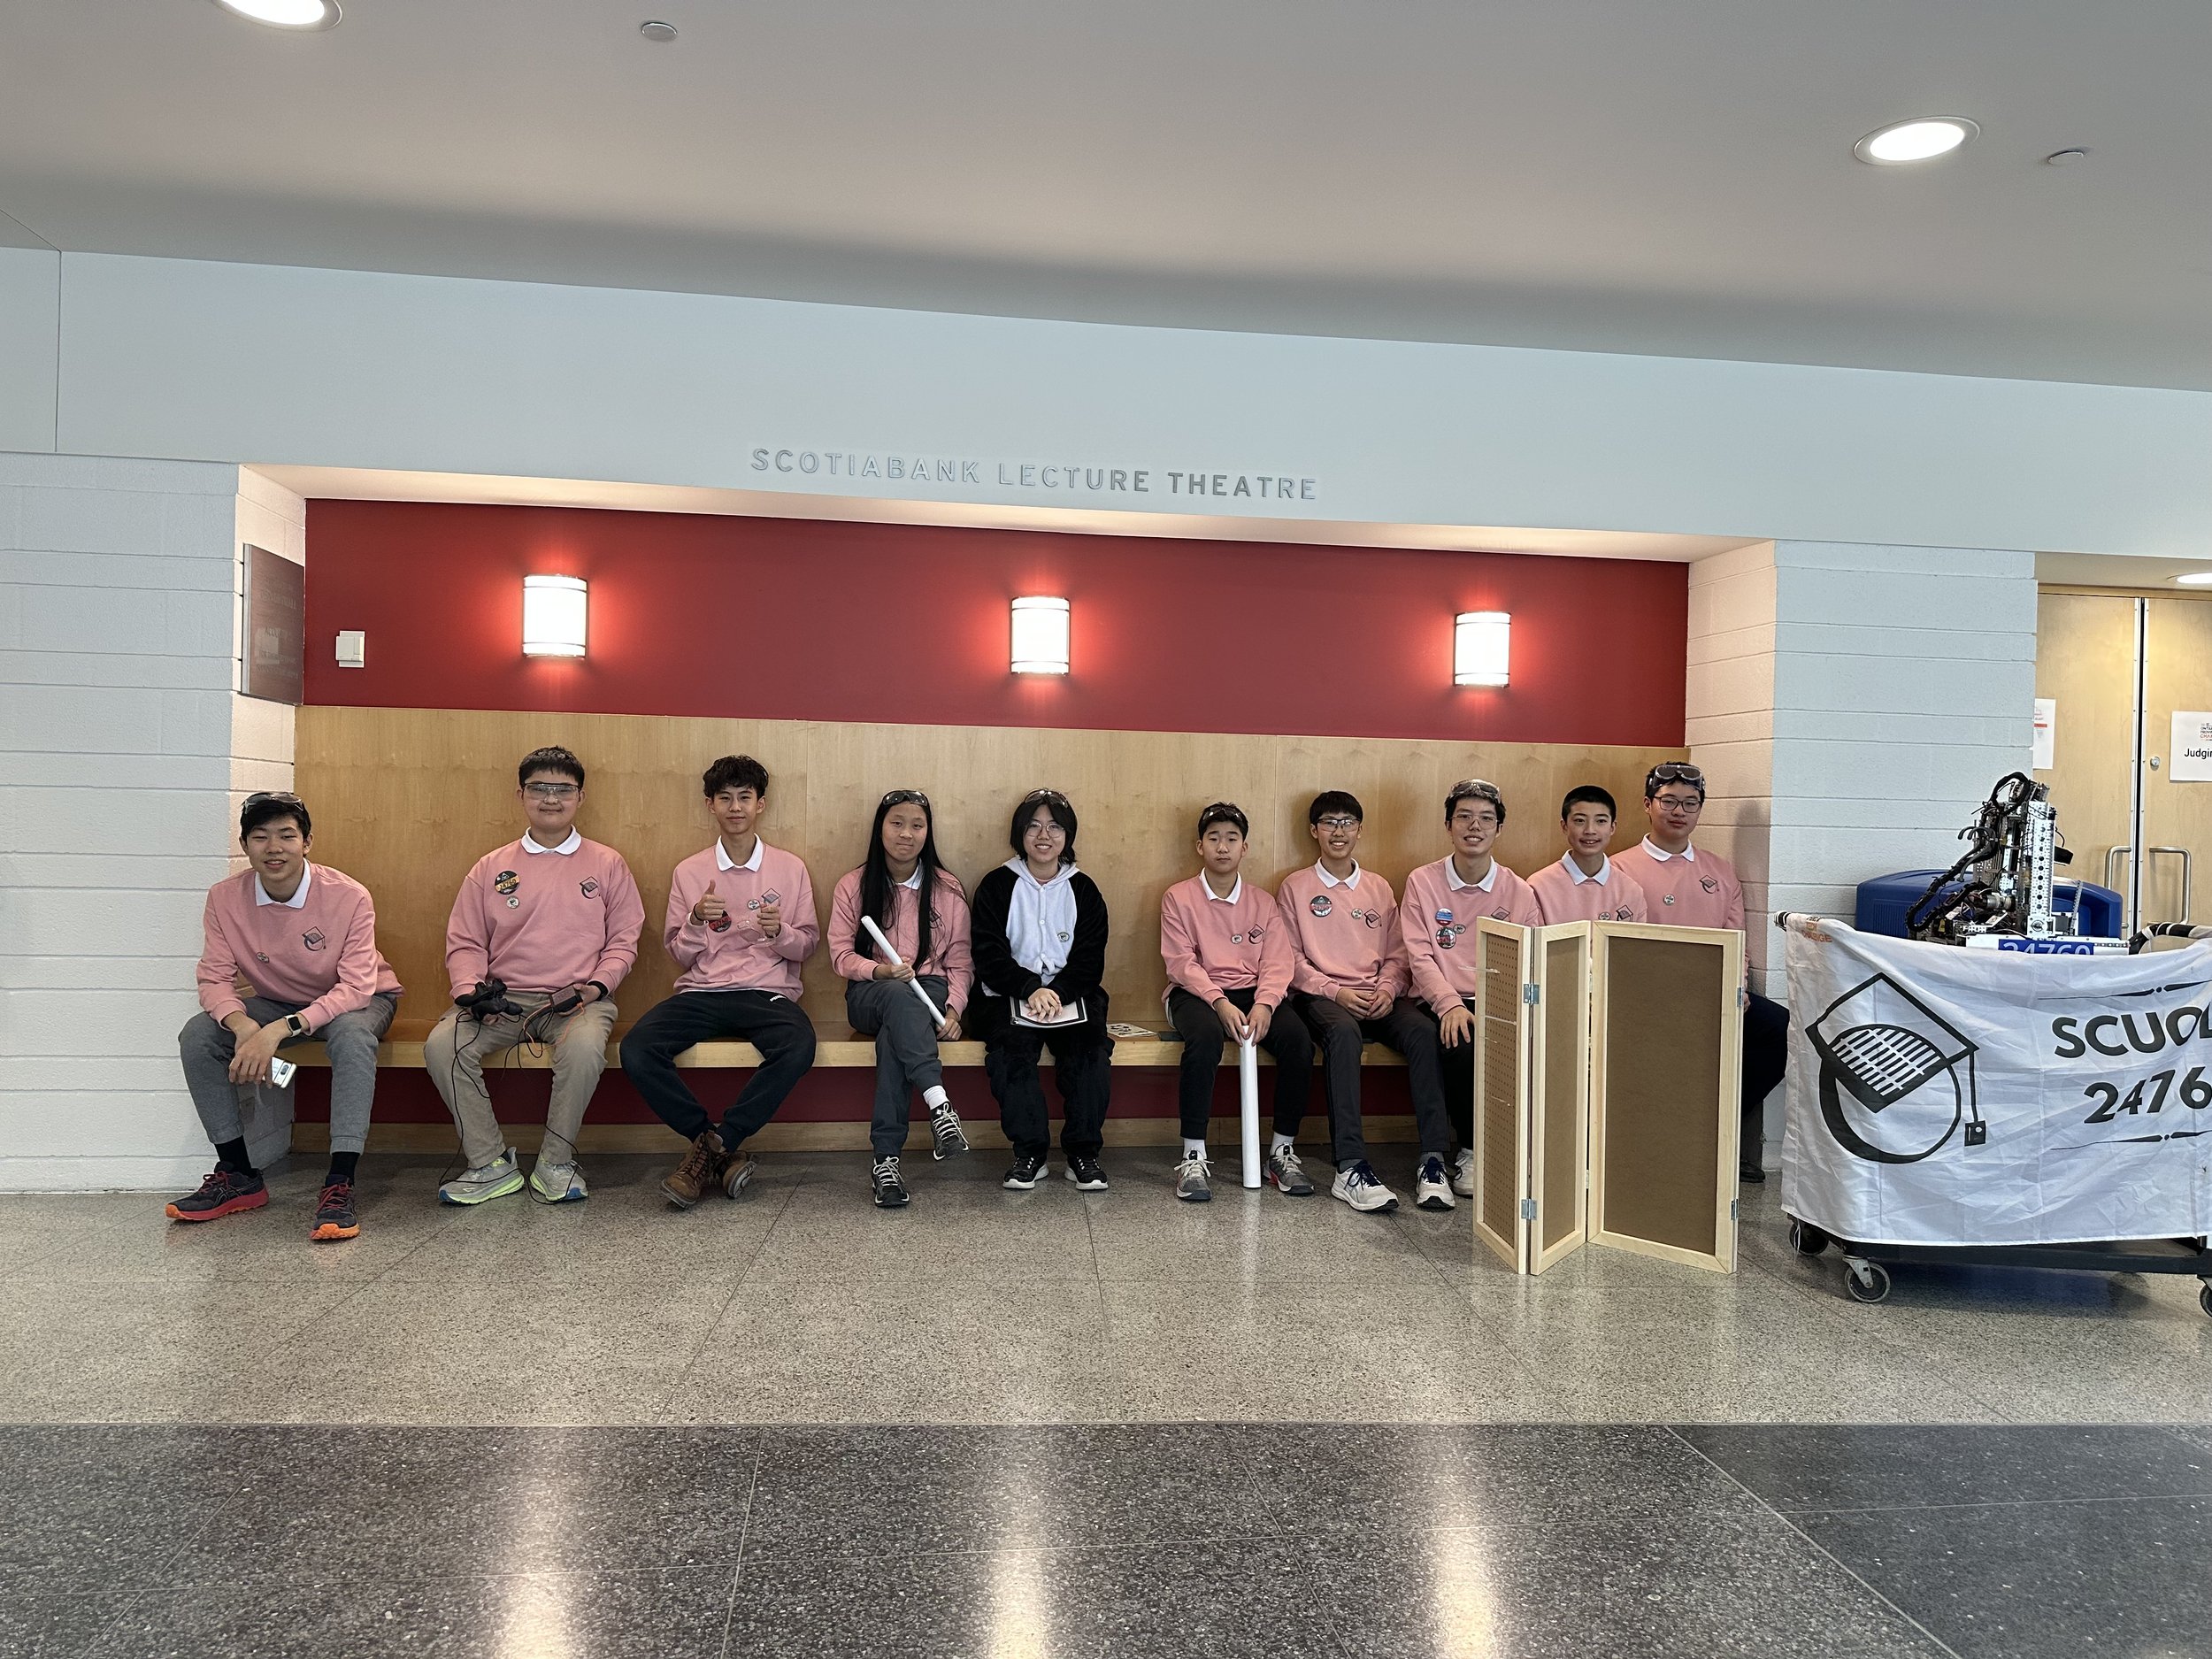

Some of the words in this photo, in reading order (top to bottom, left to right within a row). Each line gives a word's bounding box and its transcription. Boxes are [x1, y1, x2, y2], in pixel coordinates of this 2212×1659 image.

[751, 448, 979, 483] SCOTIABANK
[999, 462, 1149, 493] LECTURE
[1167, 472, 1317, 500] THEATRE
